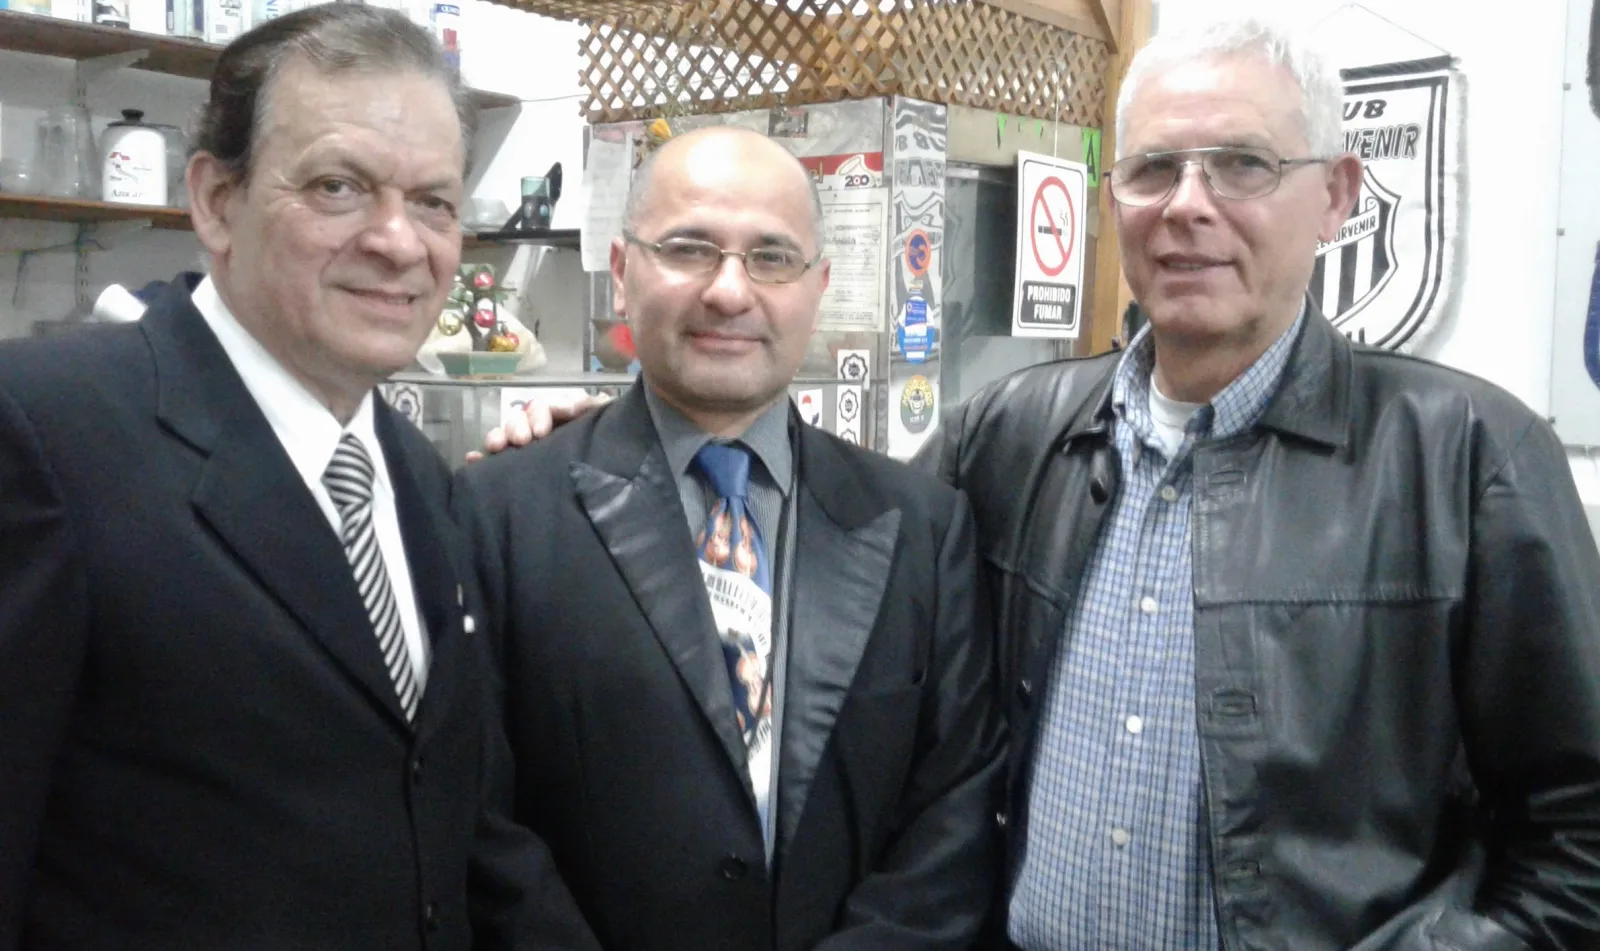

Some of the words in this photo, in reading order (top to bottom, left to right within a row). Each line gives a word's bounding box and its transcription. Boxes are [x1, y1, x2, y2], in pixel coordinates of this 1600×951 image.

[1327, 214, 1376, 246] ORVENIR
[1027, 285, 1071, 303] PROHIBIDO
[1033, 303, 1063, 320] FUMAR
